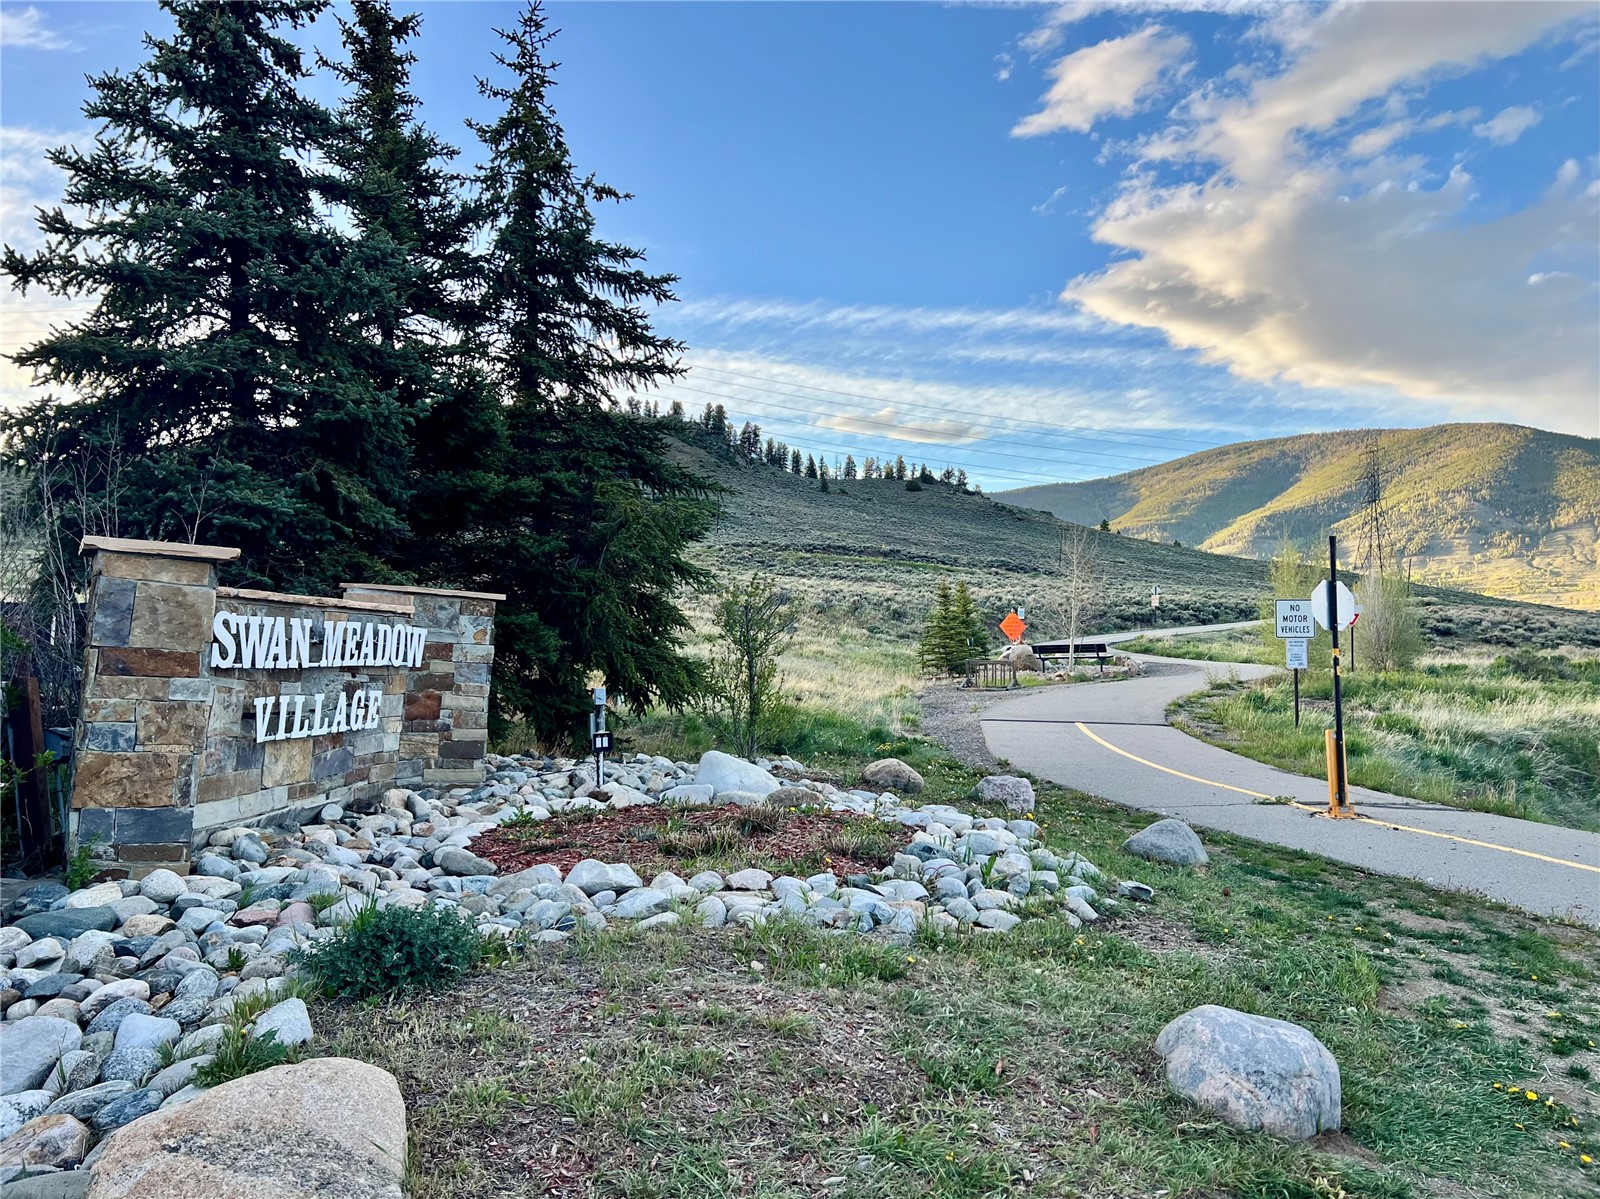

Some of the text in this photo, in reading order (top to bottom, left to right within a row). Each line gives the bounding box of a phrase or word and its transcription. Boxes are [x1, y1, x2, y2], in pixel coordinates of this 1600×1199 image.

[1289, 604, 1301, 612] NO
[1282, 614, 1308, 623] MOTOR
[1280, 625, 1310, 634] VEHICLES
[210, 610, 428, 669] SWAN MEADOW
[253, 690, 383, 743] VILLAGE
